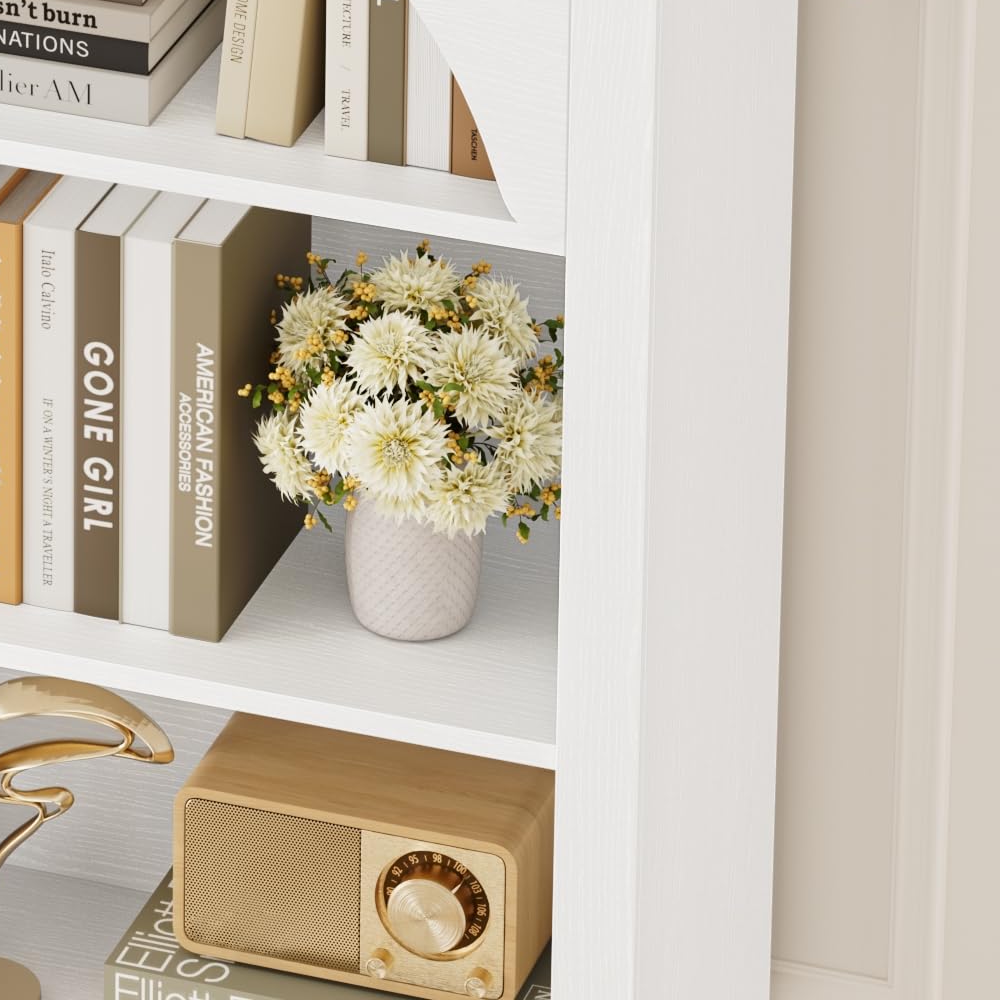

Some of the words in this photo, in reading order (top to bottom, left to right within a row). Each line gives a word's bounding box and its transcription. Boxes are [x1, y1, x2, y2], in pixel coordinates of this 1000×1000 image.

[42, 2, 98, 29] burn
[230, 21, 246, 64] DESIGN
[43, 78, 93, 106] AM
[341, 88, 352, 129] TRAVEL
[40, 249, 57, 279] Italo
[39, 281, 57, 331] Calvino
[83, 341, 114, 444] GONE
[195, 342, 215, 454] AMERICAN
[178, 392, 191, 492] ACCESSORIES
[42, 486, 53, 520] NIGHT
[83, 456, 114, 531] GIRL
[194, 458, 214, 548] FASHION
[42, 529, 53, 587] TRAVELLER
[391, 867, 403, 877] 92
[408, 854, 420, 865] 95
[432, 853, 443, 864] 98
[452, 861, 467, 875] 100
[470, 880, 482, 894] 103
[476, 903, 487, 917] 106
[468, 922, 482, 937] 108
